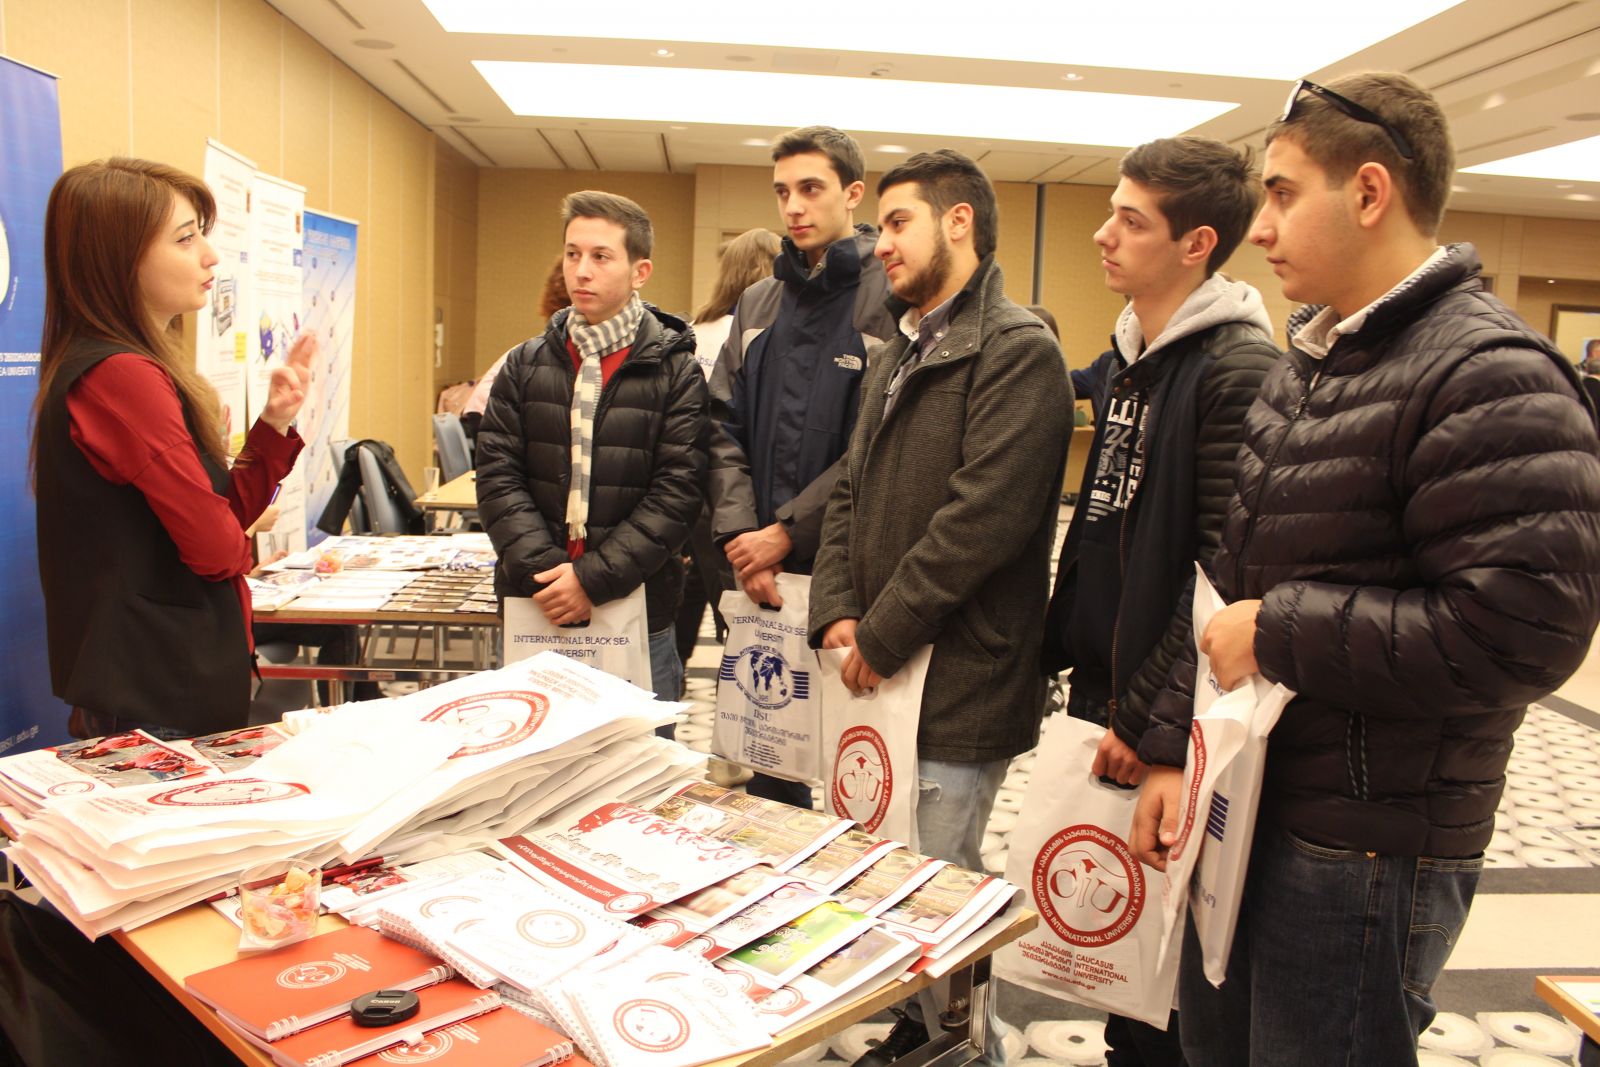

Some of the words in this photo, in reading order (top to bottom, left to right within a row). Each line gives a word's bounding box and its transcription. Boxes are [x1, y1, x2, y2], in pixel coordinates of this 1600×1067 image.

[513, 634, 584, 645] INTERNATIONAL
[585, 636, 612, 645] BLACK
[613, 637, 631, 645] SEA
[1036, 875, 1053, 918] CAUCASUS
[1050, 916, 1104, 943] INTERNATIONAL
[1103, 905, 1138, 940] UNIVERSITY
[1076, 953, 1114, 970] CAUCASUS
[1073, 970, 1114, 986] UNIVERSITY
[1074, 962, 1129, 983] INTERNATIONAL
